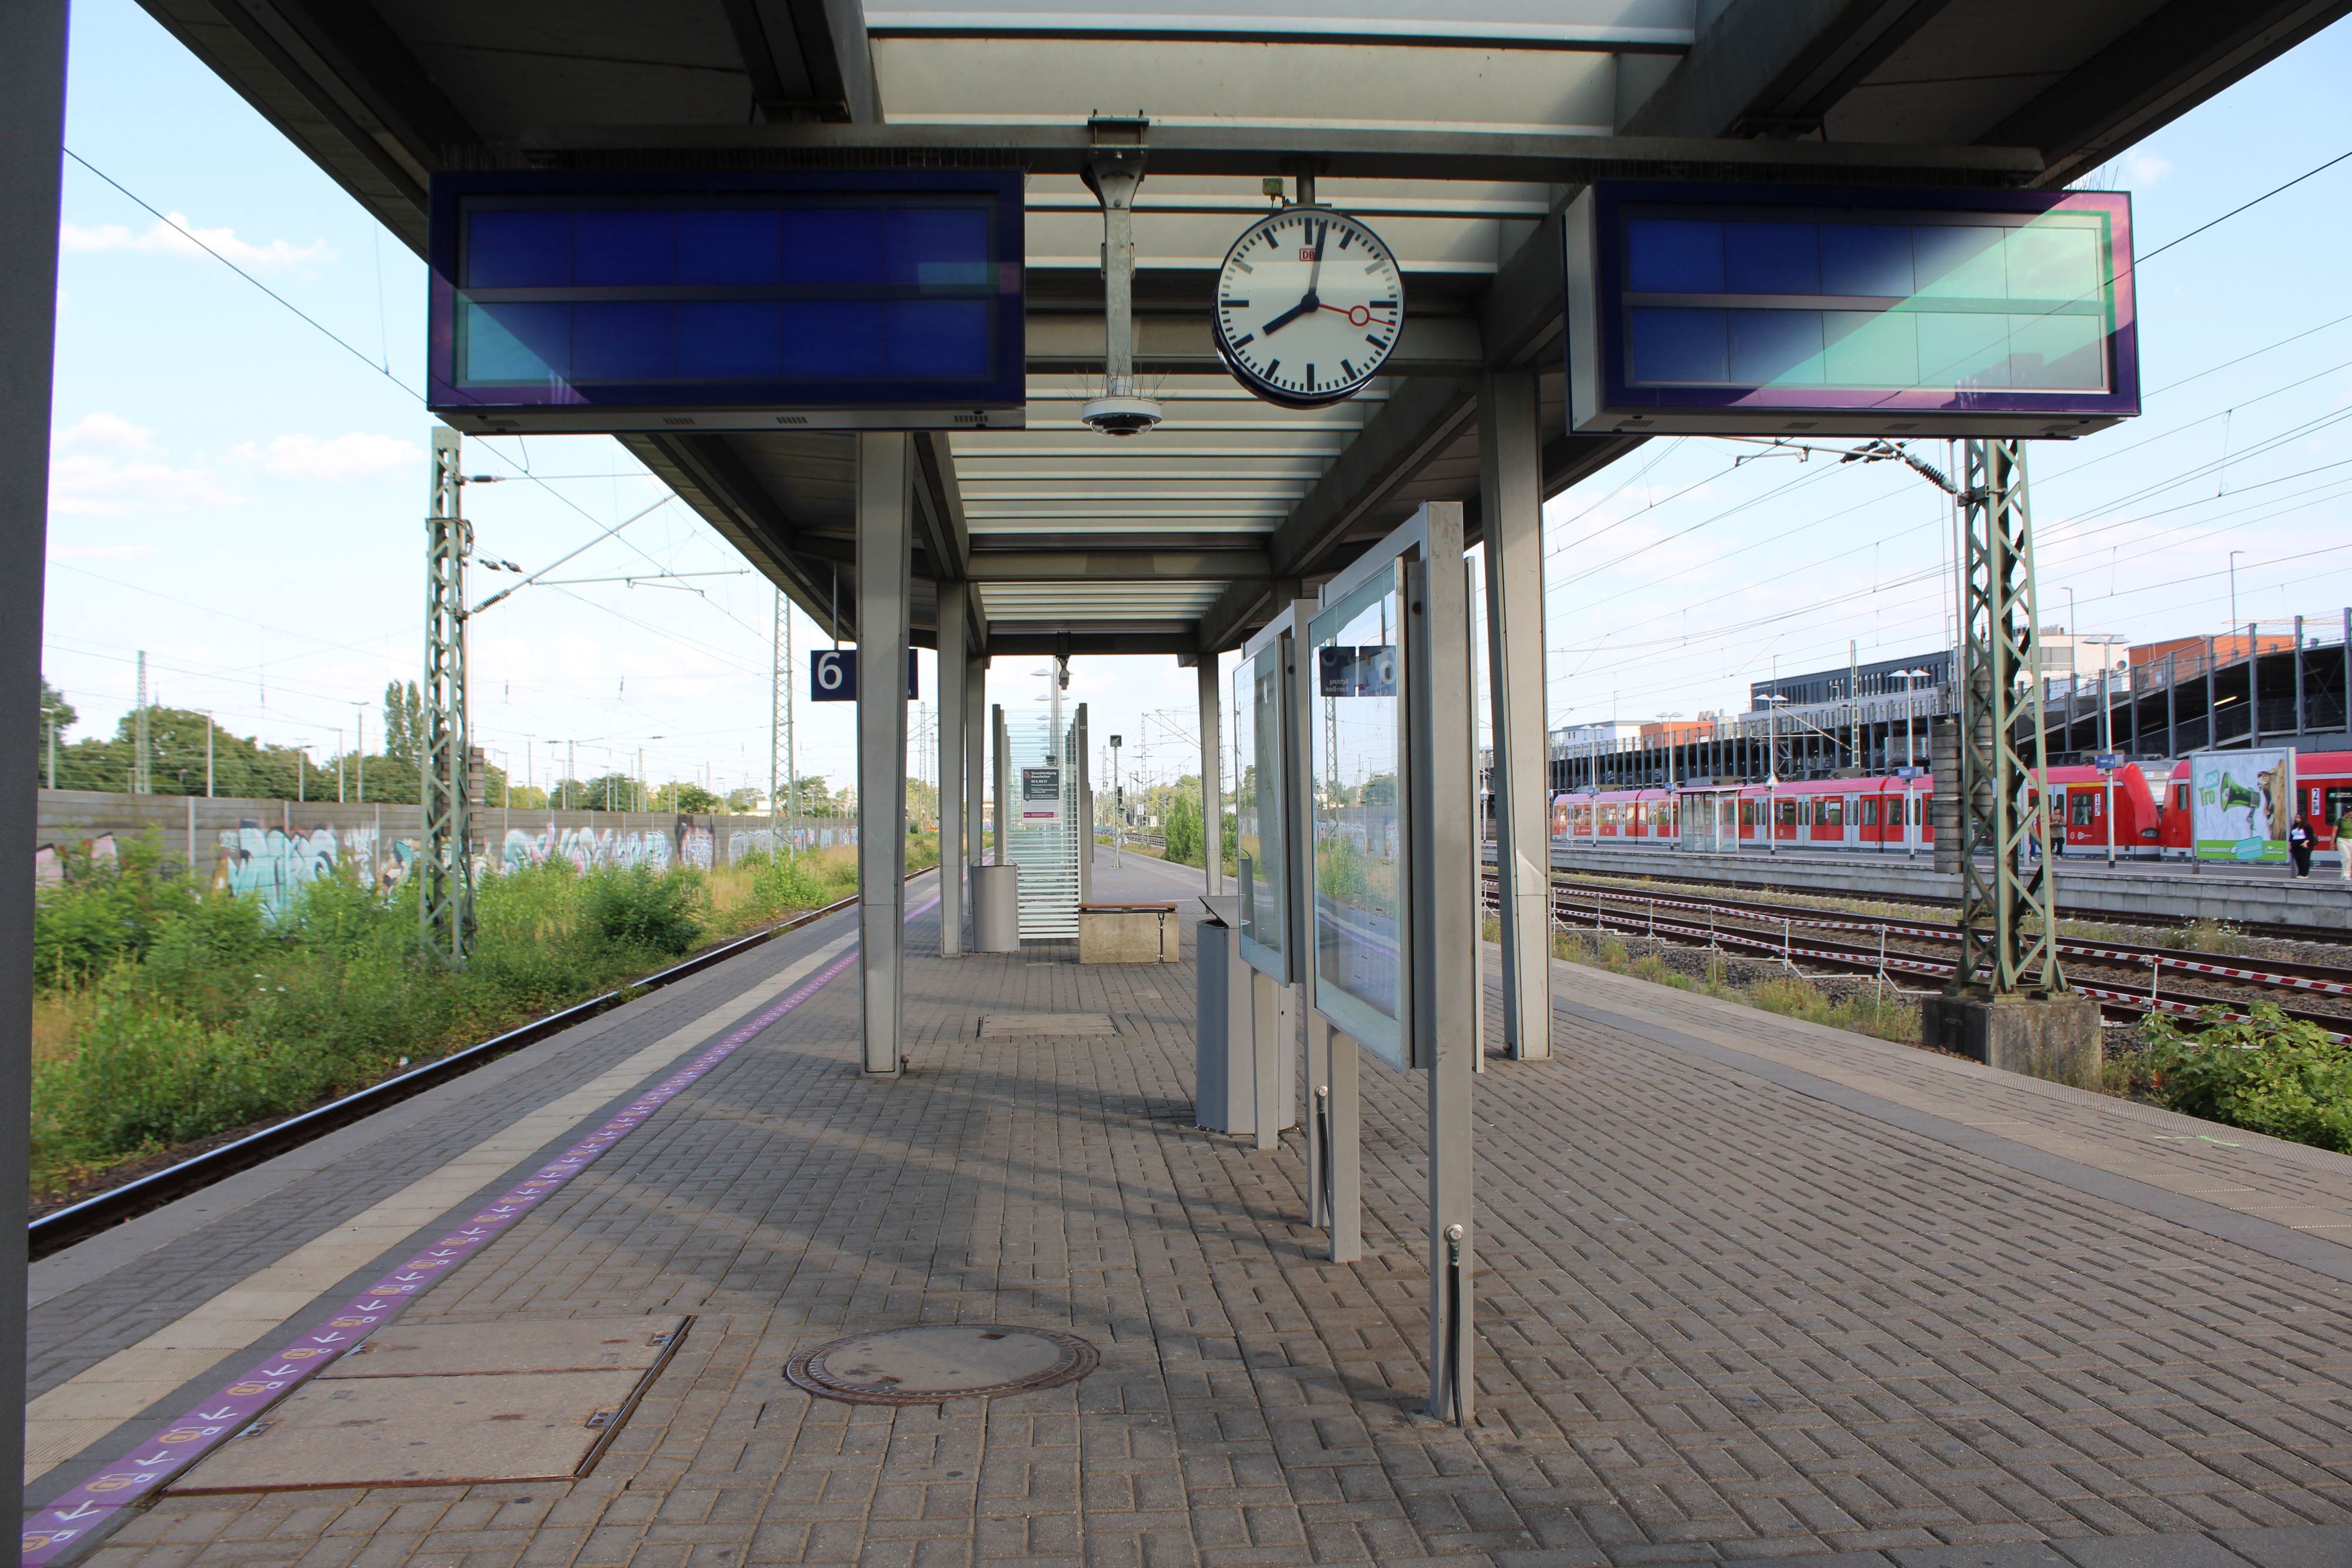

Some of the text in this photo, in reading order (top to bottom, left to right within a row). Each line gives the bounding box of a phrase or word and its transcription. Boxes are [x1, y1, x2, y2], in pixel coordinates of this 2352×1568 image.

[1302, 250, 1315, 259] DB
[818, 652, 843, 690] 6
[2198, 787, 2215, 807] Tro
[2313, 789, 2318, 800] 2
